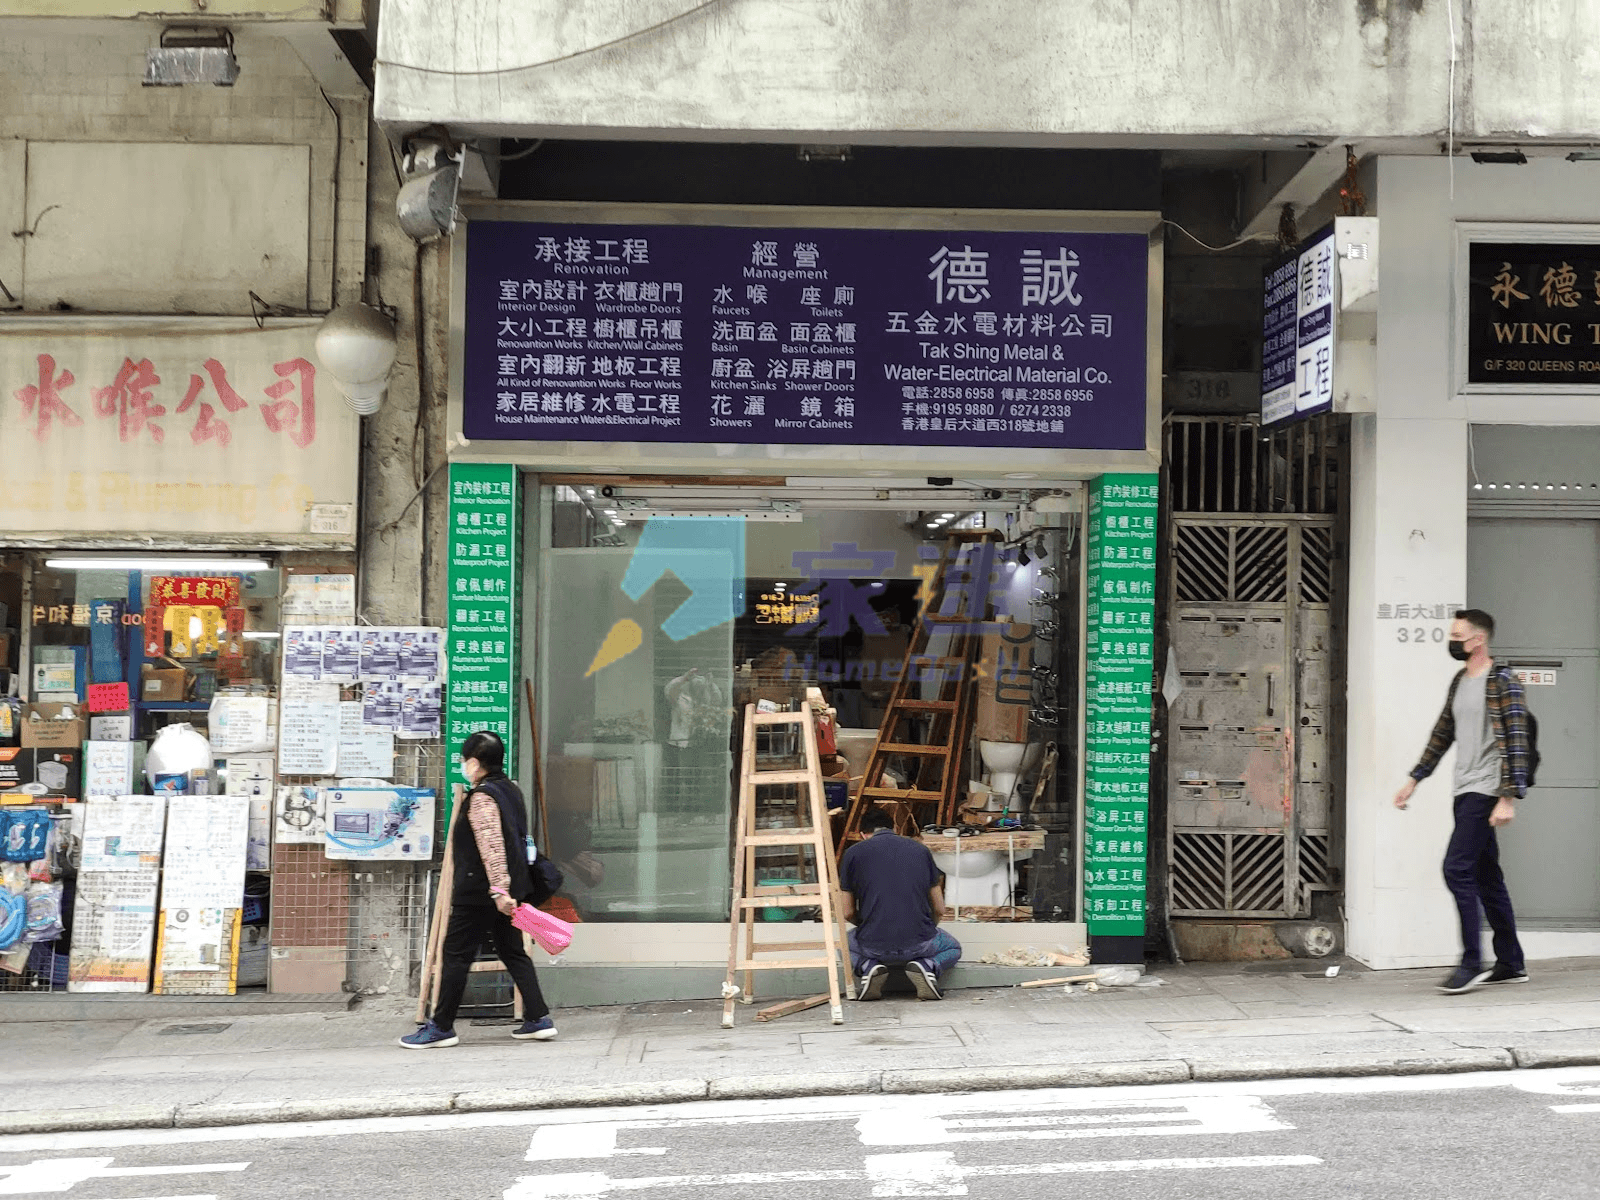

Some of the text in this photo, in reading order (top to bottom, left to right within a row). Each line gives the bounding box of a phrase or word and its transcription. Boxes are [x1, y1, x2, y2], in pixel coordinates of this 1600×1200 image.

[534, 237, 649, 264] 承接工程
[554, 263, 630, 275] Renovation
[743, 266, 828, 281] Management
[928, 245, 1083, 307] 德誠
[499, 279, 683, 303] 室內設計 衣櫃趟門
[498, 302, 681, 314] Interior Design Wardrobe Doors
[712, 305, 843, 317] Faucets Toilets
[498, 316, 588, 339] 大小工程
[712, 320, 857, 343] 洗面盆 面盆櫃
[885, 310, 1112, 338] 五金水電材料公司
[1492, 322, 1573, 345] WING
[497, 339, 553, 349] Renovantion
[553, 340, 583, 350] Works
[644, 341, 684, 351] Cabinets
[711, 342, 854, 355] Basin Basin Cabinets
[919, 342, 1064, 363] Tak Shing Metal &
[497, 354, 682, 377] 室內翻新 地板工程
[766, 358, 856, 380] 浴屏趟門
[1484, 359, 1505, 371] G/F
[1506, 360, 1526, 371] 320
[1528, 360, 1575, 372] QUEENS
[884, 364, 1112, 384] Water-Electrical Material Co.
[497, 378, 682, 389] All Kind of Renovantion Works Floor Works
[711, 380, 855, 392] Kitchen Sinks Shower Doors
[965, 387, 995, 400] 6958
[1063, 389, 1094, 401] 6956
[496, 391, 681, 414] 家居維修 水電工程
[965, 403, 995, 416] 9880
[1010, 404, 1040, 416] 6274
[1042, 405, 1071, 417] 2338
[495, 414, 681, 427] House Maintenance Water&Electrical Project
[710, 417, 853, 429] Showers Mirror Cabinets
[1397, 627, 1444, 643] 320
